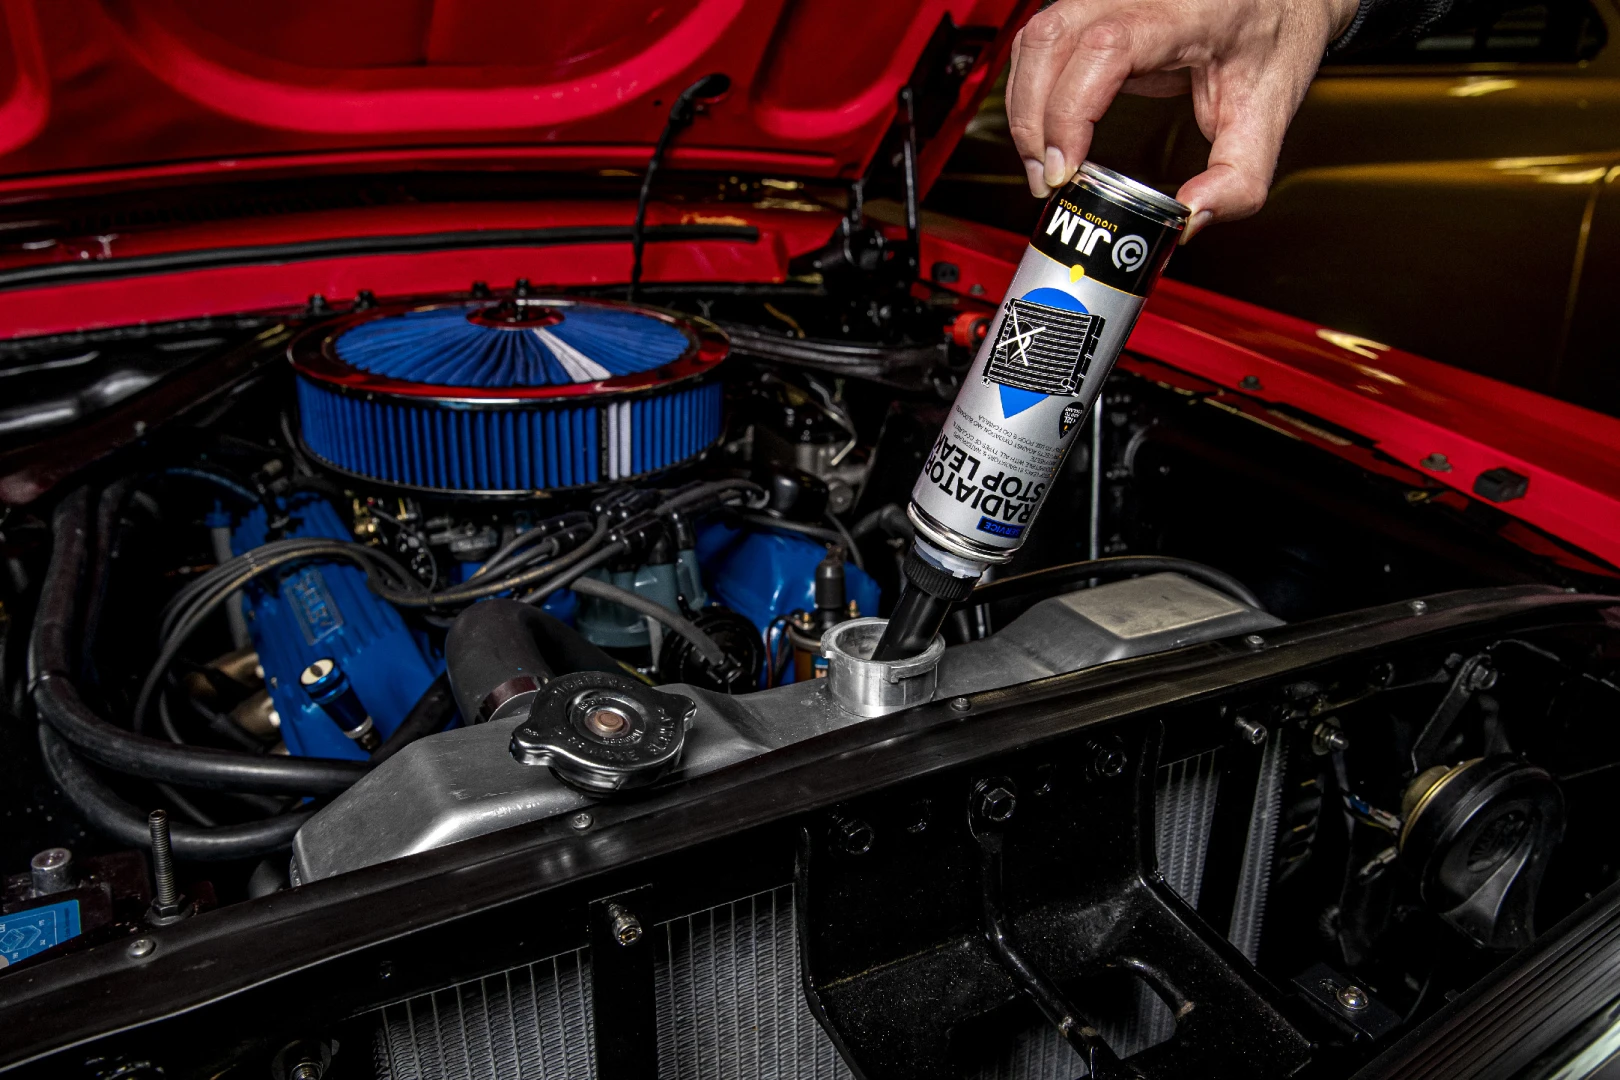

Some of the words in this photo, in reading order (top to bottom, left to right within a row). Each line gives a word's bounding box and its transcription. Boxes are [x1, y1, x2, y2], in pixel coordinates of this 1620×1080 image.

[1059, 198, 1082, 215] TOOLS
[1085, 211, 1118, 232] LIQUID
[1046, 206, 1111, 256] JLM
[932, 428, 980, 480] LEAK
[924, 450, 1035, 523] RADIATOR
[981, 470, 1045, 503] STOP
[984, 521, 1020, 536] SERVICE
